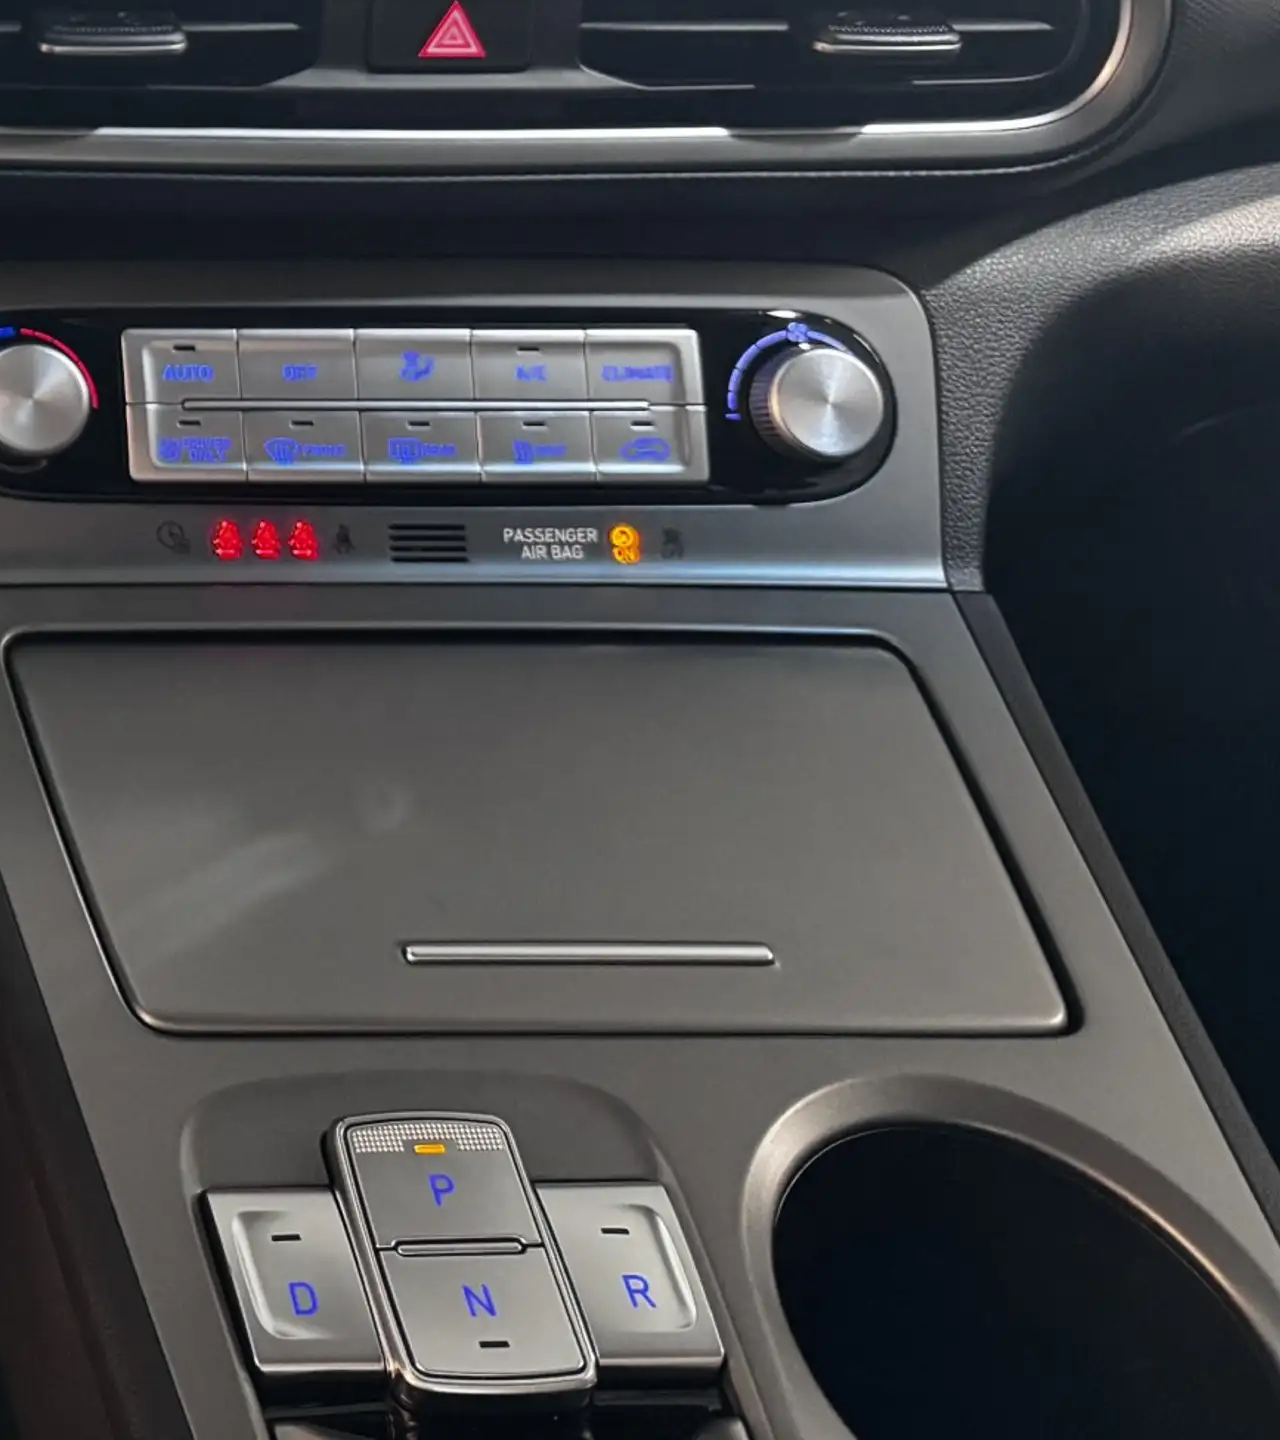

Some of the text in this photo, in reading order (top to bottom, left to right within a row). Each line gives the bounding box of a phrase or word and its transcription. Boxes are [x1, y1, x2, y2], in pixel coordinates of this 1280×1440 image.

[161, 363, 216, 383] AUTO
[502, 526, 599, 544] PASSENGER
[520, 544, 585, 560] AIR BAG
[428, 1172, 456, 1207] P
[288, 1281, 320, 1317] D
[460, 1283, 499, 1319] N
[621, 1274, 657, 1310] R
